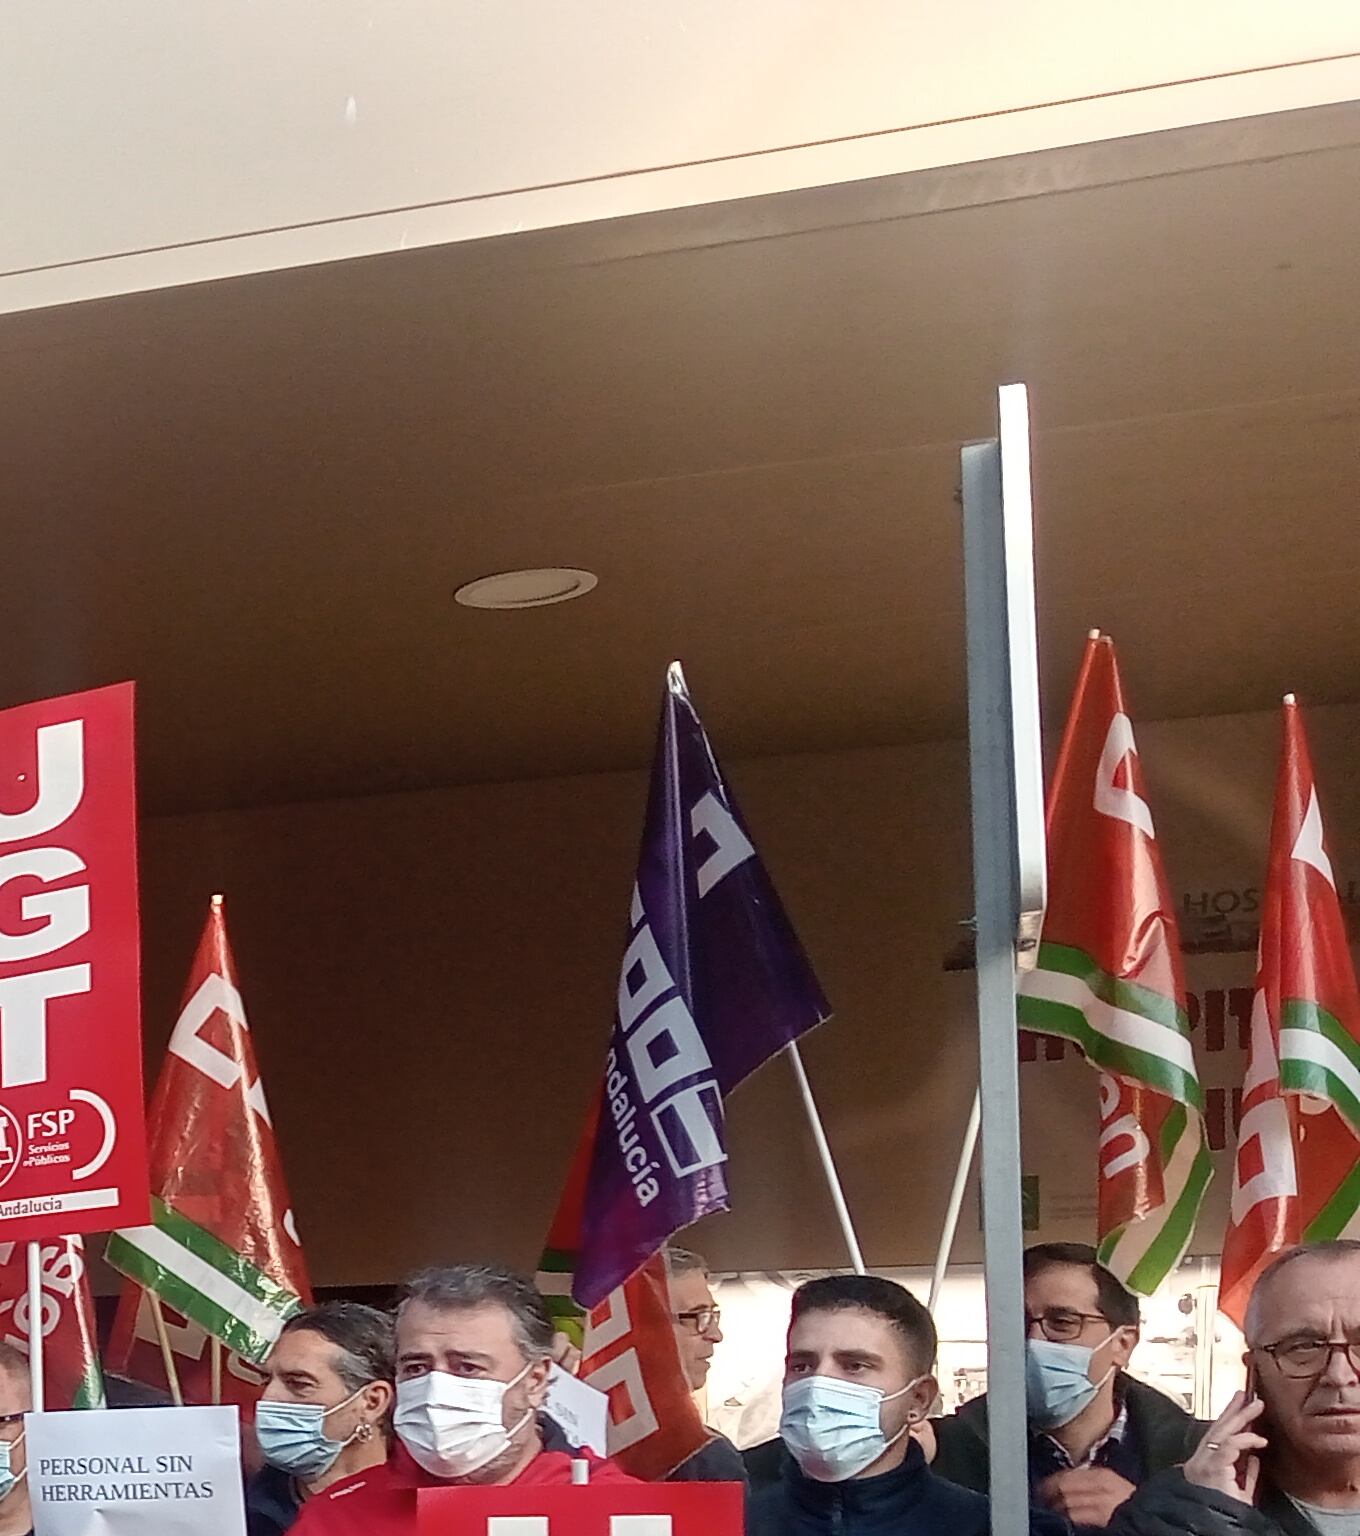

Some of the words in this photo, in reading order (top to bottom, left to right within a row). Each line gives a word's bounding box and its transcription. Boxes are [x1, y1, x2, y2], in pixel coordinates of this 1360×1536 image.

[27, 1109, 75, 1139] FSP
[39, 1456, 150, 1476] PERSONAL
[156, 1455, 193, 1474] SIN
[41, 1481, 214, 1502] HERRAMIENTAS
